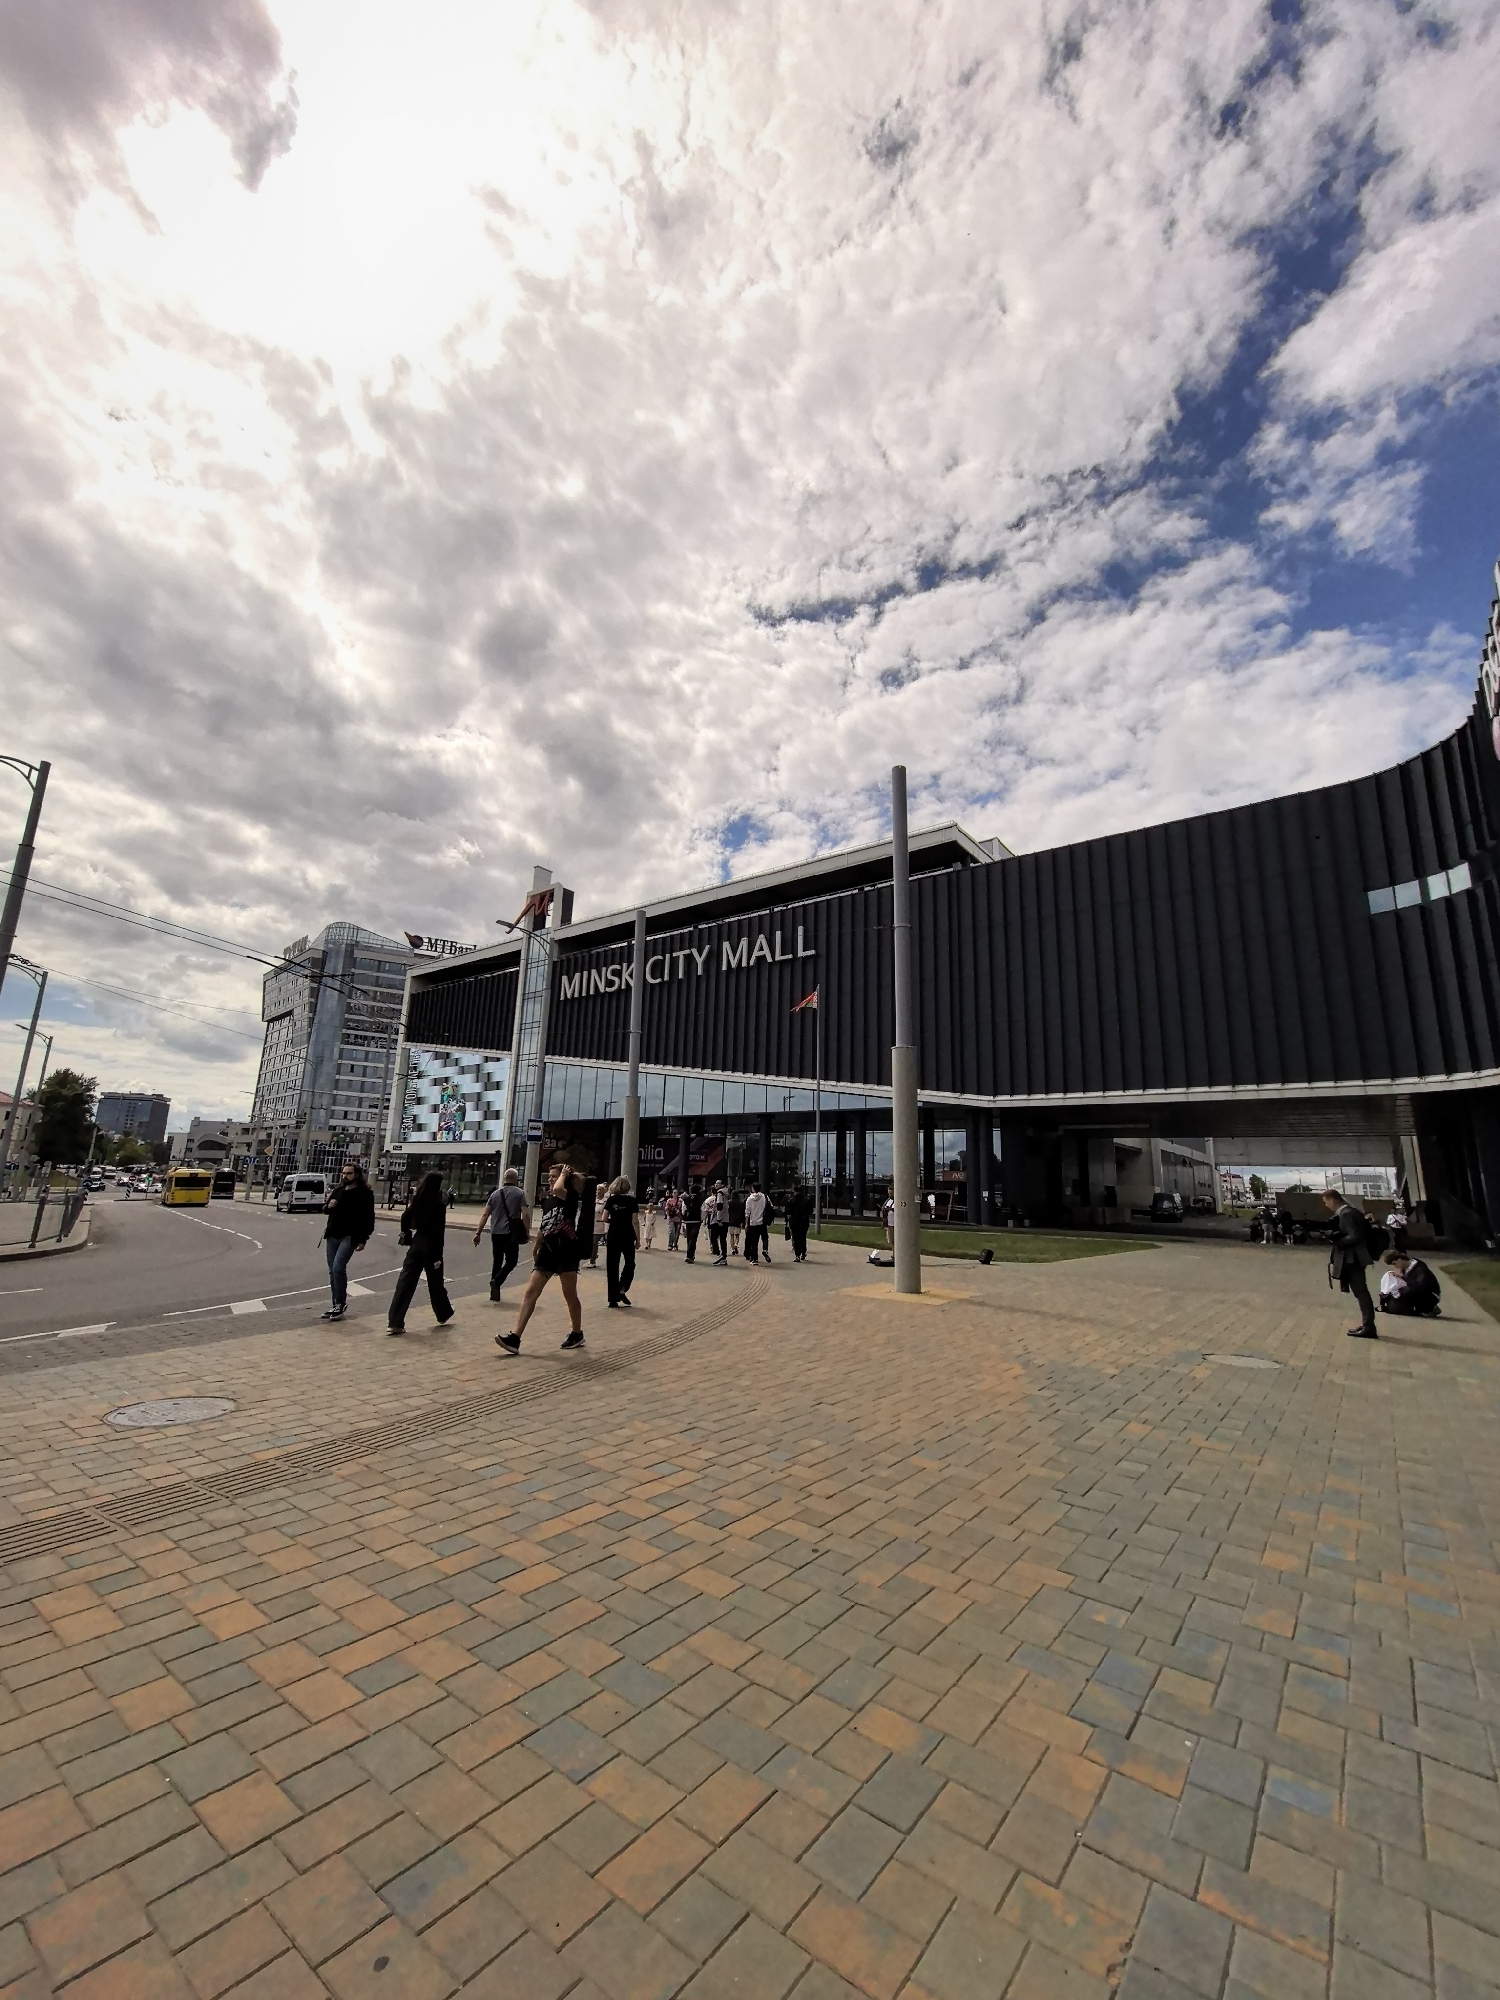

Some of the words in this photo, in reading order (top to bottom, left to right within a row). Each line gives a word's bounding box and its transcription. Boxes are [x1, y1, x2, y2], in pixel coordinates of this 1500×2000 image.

[560, 962, 634, 1001] MINSK
[645, 944, 711, 985] CITY
[721, 925, 816, 972] MALL
